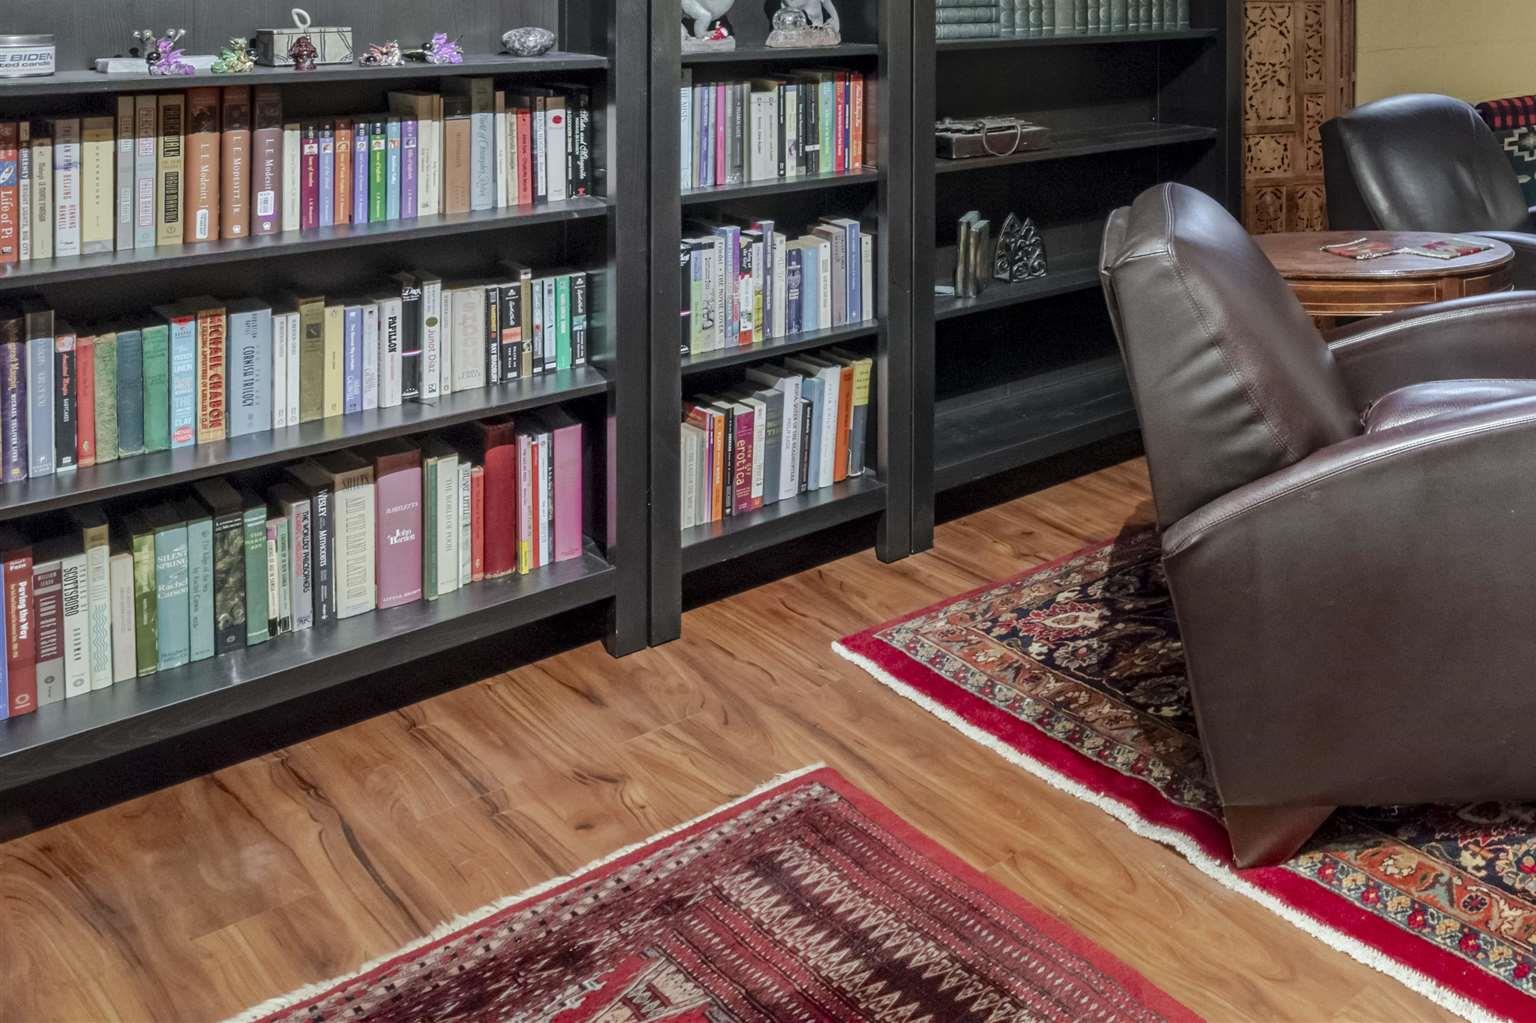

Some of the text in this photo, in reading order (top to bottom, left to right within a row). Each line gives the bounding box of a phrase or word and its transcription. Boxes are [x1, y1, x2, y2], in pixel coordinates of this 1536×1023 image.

[10, 52, 53, 62] BIDEN
[163, 136, 181, 158] WALK
[0, 190, 13, 239] Life of Pi
[388, 316, 397, 353] PAPILLON
[428, 328, 437, 352] Junot
[208, 314, 223, 428] MICHAEL CHABON
[242, 346, 255, 407] CORNISH TRILOGY
[736, 439, 747, 486] erotica
[302, 511, 310, 522] THE
[318, 489, 329, 517] WESLEY
[63, 566, 80, 617] SCOTTSBORO
[302, 552, 310, 593] PHILOSOPHERS
[17, 580, 28, 639] Paving the Way
[39, 629, 58, 658] DESIRE
